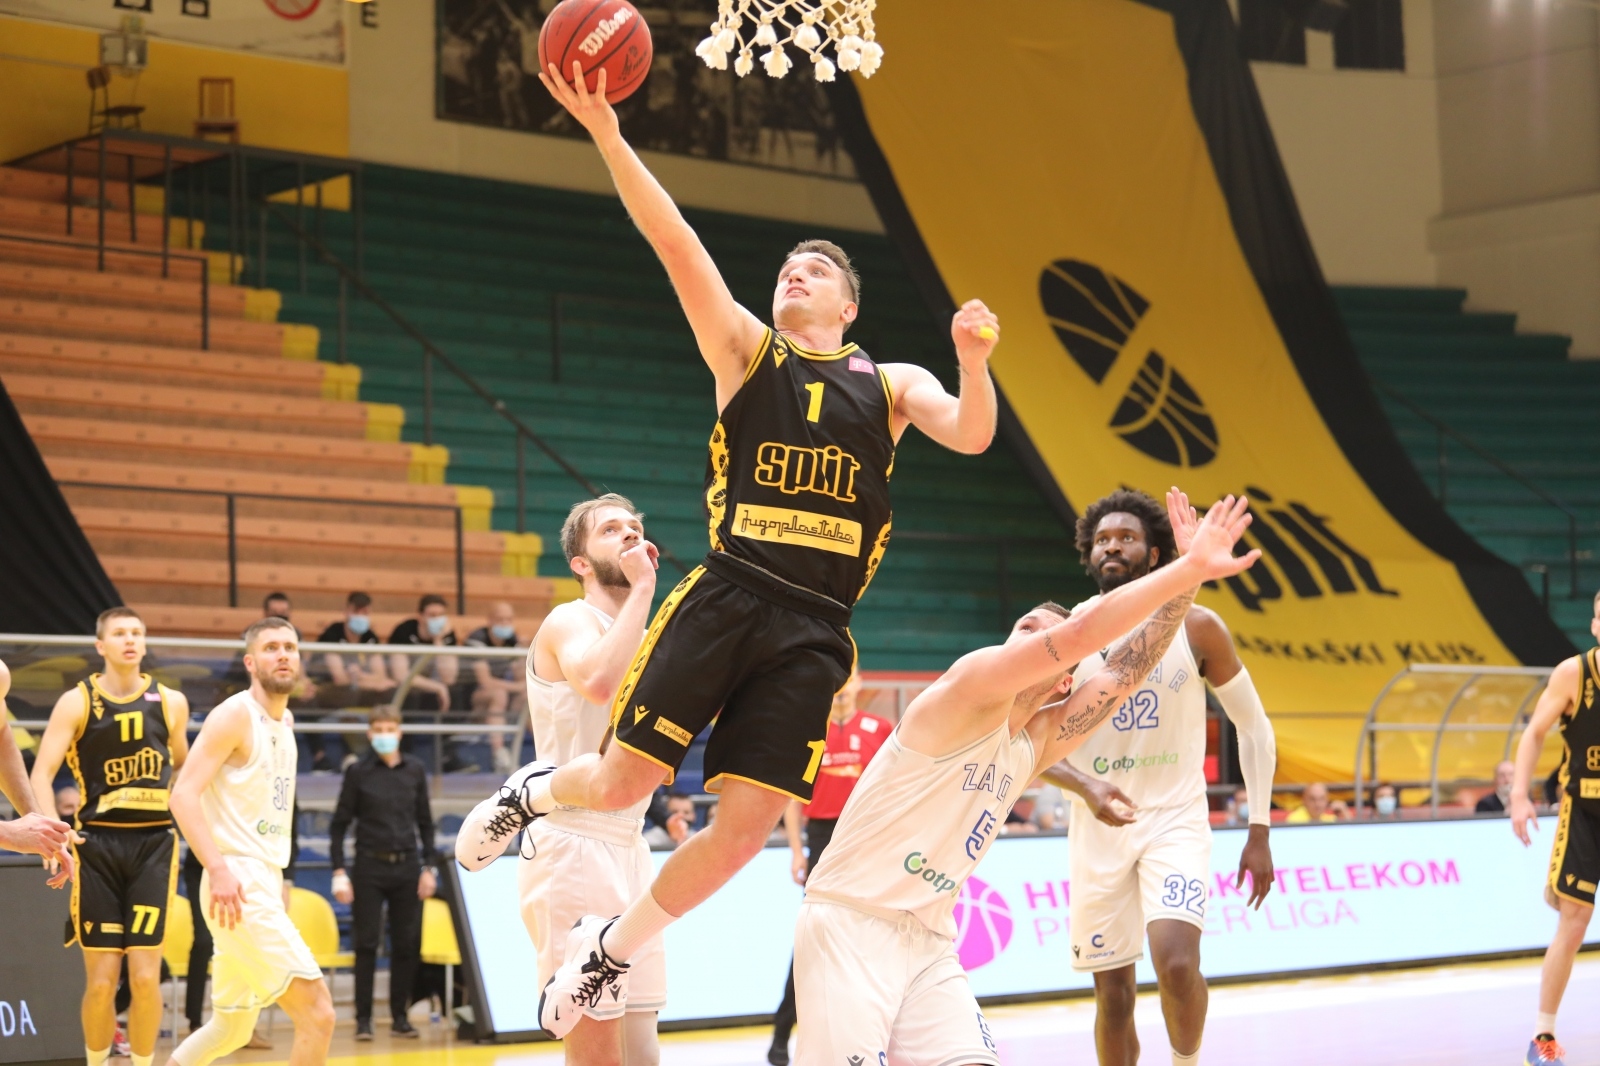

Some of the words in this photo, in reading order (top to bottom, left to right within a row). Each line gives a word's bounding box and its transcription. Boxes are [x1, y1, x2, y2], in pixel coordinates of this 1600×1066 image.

[578, 7, 633, 57] Wilson
[805, 381, 825, 423] 1
[754, 442, 861, 502] split
[1195, 487, 1399, 613] plit
[1112, 689, 1159, 731] 32
[802, 739, 826, 784] 1
[965, 809, 997, 861] 5
[1162, 874, 1206, 918] 32
[1273, 859, 1462, 897] TELEKOM
[1264, 898, 1360, 931] LIGA
